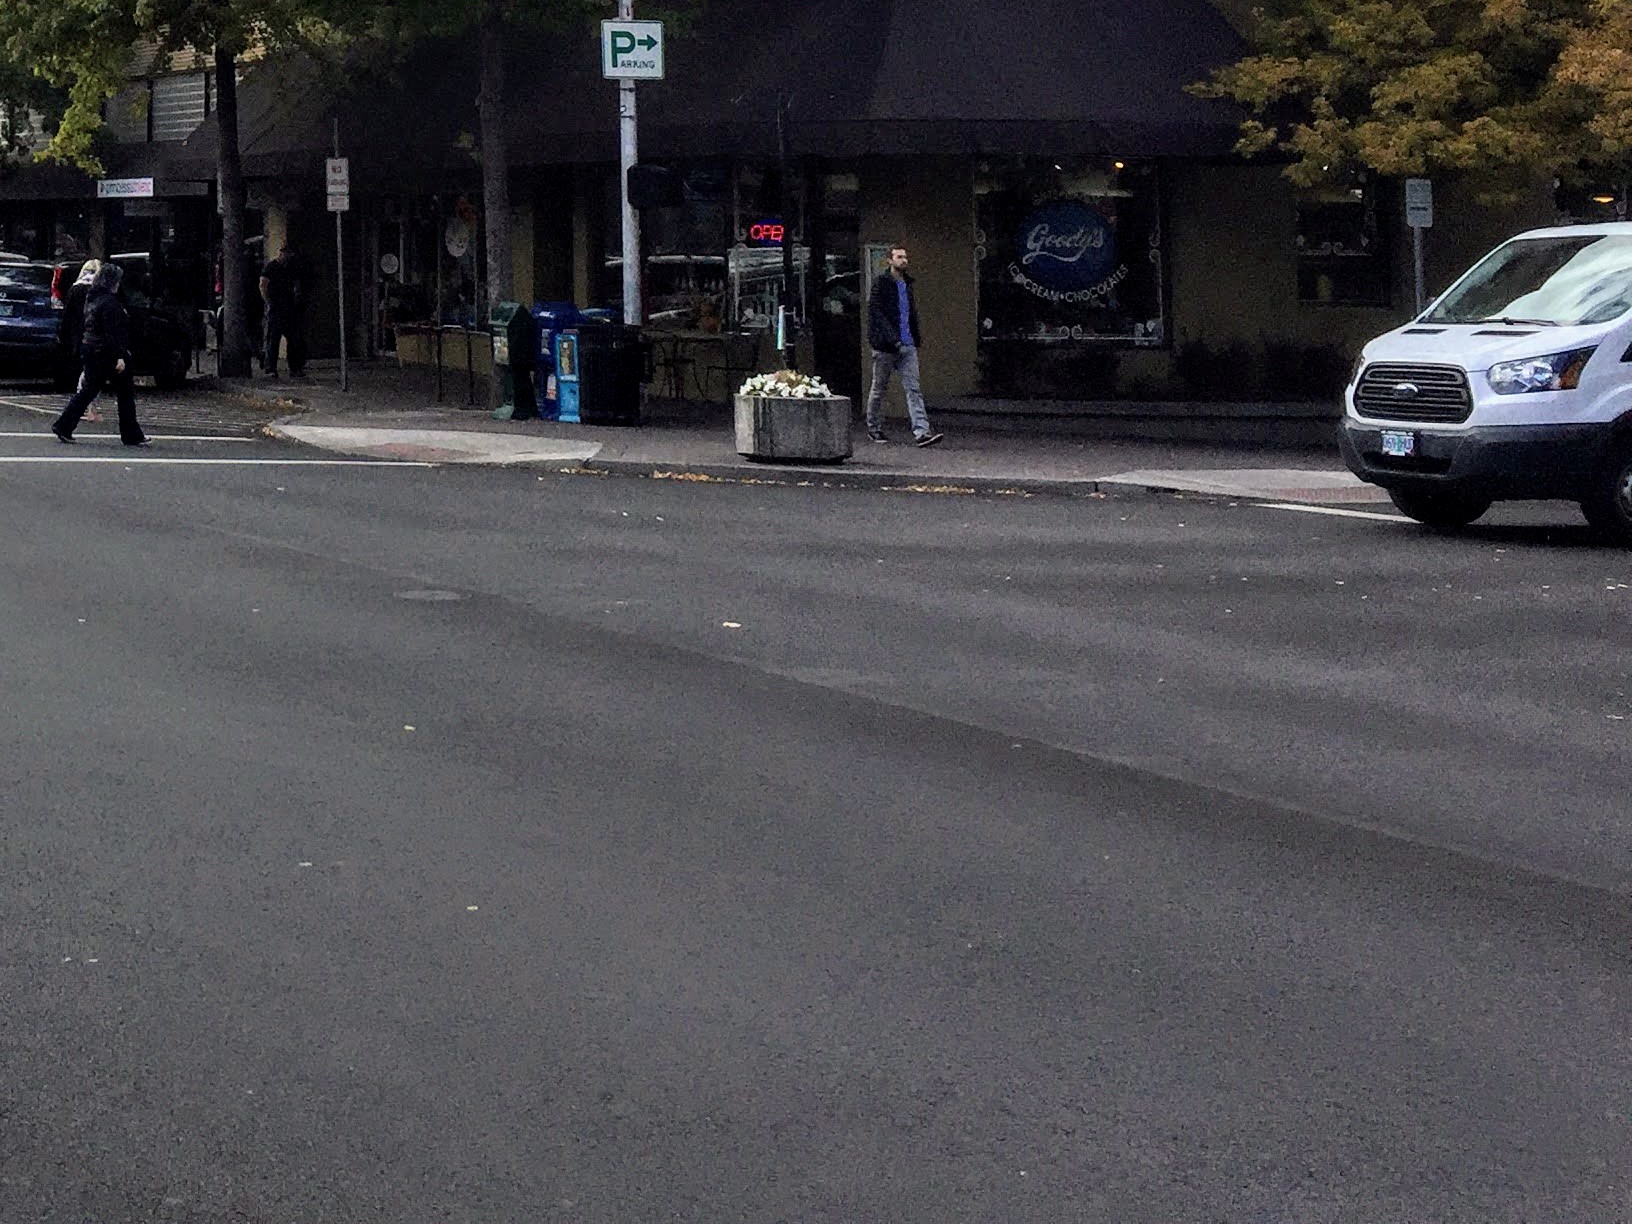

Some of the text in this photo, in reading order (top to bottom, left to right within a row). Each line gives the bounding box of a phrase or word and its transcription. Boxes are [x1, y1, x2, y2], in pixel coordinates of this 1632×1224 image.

[1022, 223, 1104, 265] Goody's
[1023, 278, 1060, 302] CREAM
[1065, 263, 1129, 303] CHOCOLATES
